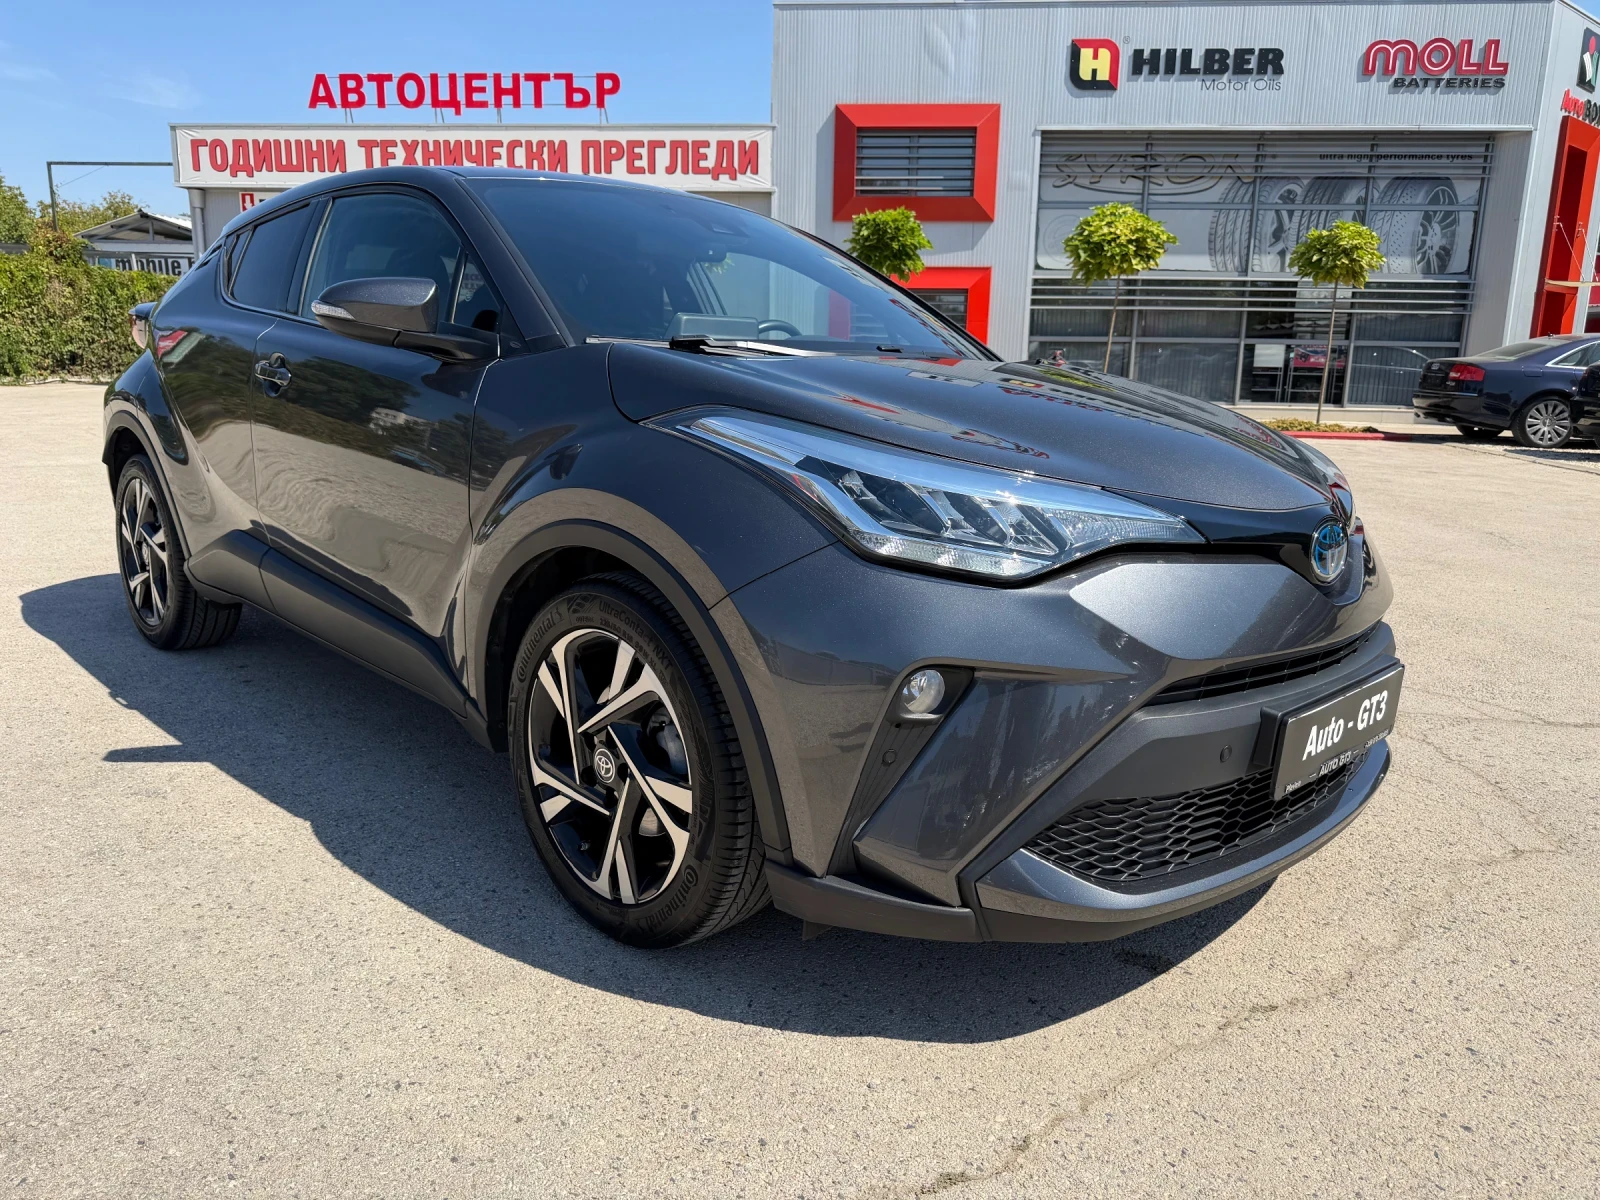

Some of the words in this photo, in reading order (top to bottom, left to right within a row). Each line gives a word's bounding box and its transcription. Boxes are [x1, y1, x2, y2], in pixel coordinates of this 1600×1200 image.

[1131, 47, 1285, 76] HILBER
[1361, 37, 1509, 76] MOLL
[308, 72, 621, 116] АВТОЦЕНТЪР
[1200, 78, 1249, 91] Motor
[1253, 78, 1282, 91] Oils
[1393, 77, 1506, 89] BATTERIES
[190, 138, 347, 177] ГОДИШНИ
[357, 139, 569, 172] ТЕХНИЧЕСКИ
[580, 139, 760, 181] ПРЕГЛЕДИ
[1446, 152, 1473, 163] tyres
[516, 611, 557, 684] Continental
[652, 643, 675, 671] NXT
[1302, 716, 1345, 761] Auto
[1357, 690, 1388, 731] GT3
[644, 864, 699, 932] Continental
